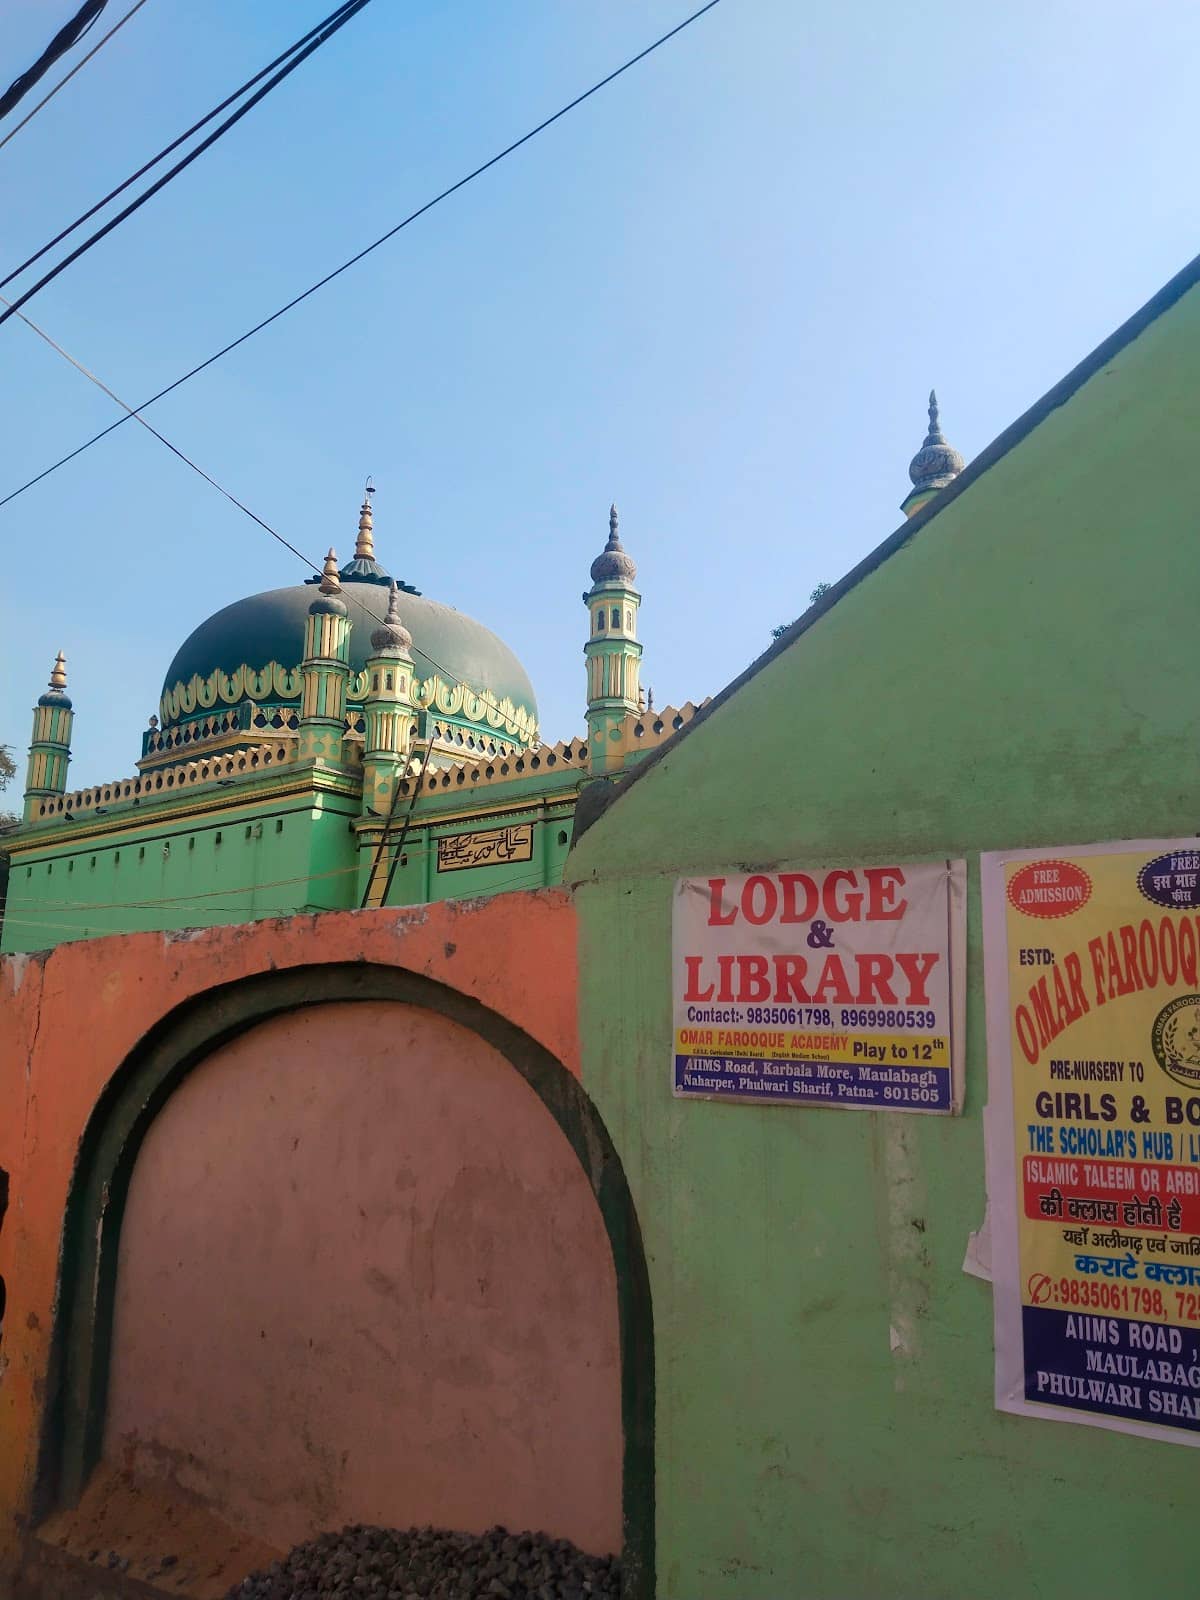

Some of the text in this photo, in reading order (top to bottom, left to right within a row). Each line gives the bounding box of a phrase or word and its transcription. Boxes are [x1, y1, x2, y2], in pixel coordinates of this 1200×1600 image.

[1033, 869, 1060, 883] FREE
[1152, 873, 1197, 891] इस माह
[707, 867, 909, 927] LODGE
[1019, 886, 1083, 904] ADMISSION
[1170, 888, 1192, 902] फीस
[806, 920, 835, 949] &
[1019, 948, 1055, 966] ESTD:
[683, 953, 940, 1006] LIBRARY
[1014, 915, 1200, 1065] OMAR FAROOQ
[746, 1008, 835, 1028] 9835061798,
[841, 1010, 936, 1029] 8969980539
[680, 1030, 849, 1050] OMAR FAROOQUE ACADEMY
[853, 1038, 944, 1060] Play to 12th
[685, 1057, 938, 1087] AIIMS Road, Karbala More, Maulabagh
[1050, 1060, 1144, 1082] PRE-NURSERY TO
[684, 1075, 940, 1103] Naharper, Phulwari Sharif, Patna- 801505
[1035, 1091, 1117, 1122] GIRLS
[1130, 1095, 1151, 1123] &
[1027, 1125, 1054, 1153] THE
[1059, 1125, 1137, 1158] SCHOLAR'S
[1142, 1131, 1174, 1161] HUB
[1026, 1160, 1080, 1186] ISLAMIC
[1084, 1164, 1135, 1190] TALEEM
[1140, 1169, 1161, 1193] OR
[1039, 1188, 1182, 1230] की क्लास होती है
[1146, 1235, 1168, 1253] एवं
[1074, 1252, 1139, 1280] कराटे
[1175, 1290, 1200, 1321] 72
[1065, 1314, 1121, 1345] AIIMS
[1128, 1322, 1183, 1354] ROAD
[1036, 1371, 1142, 1409] PHULWARI
